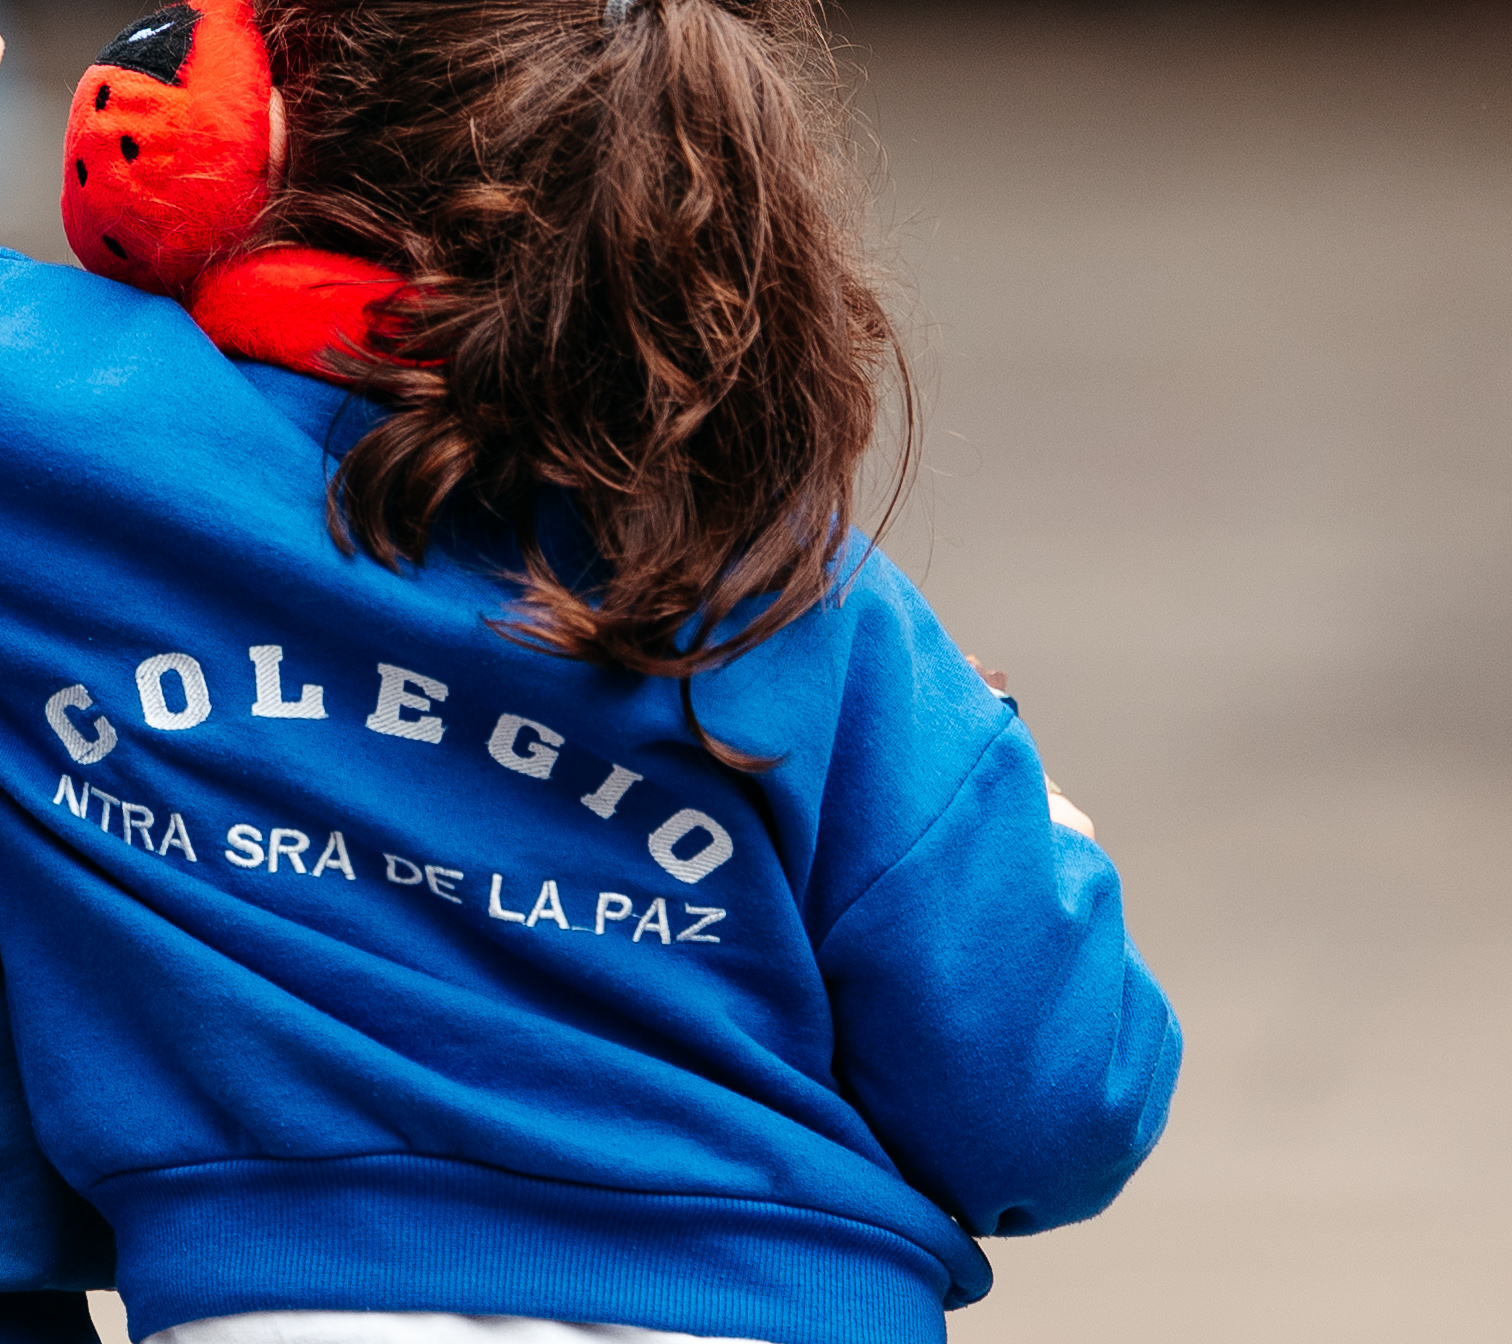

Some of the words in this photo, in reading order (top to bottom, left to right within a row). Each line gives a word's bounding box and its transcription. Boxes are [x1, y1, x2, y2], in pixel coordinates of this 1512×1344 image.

[44, 644, 734, 884] COLEGIO
[52, 774, 198, 862] NTRA
[224, 823, 357, 881] SRA
[382, 853, 464, 904] DE
[487, 873, 570, 931] LA
[595, 891, 727, 945] PAZ
